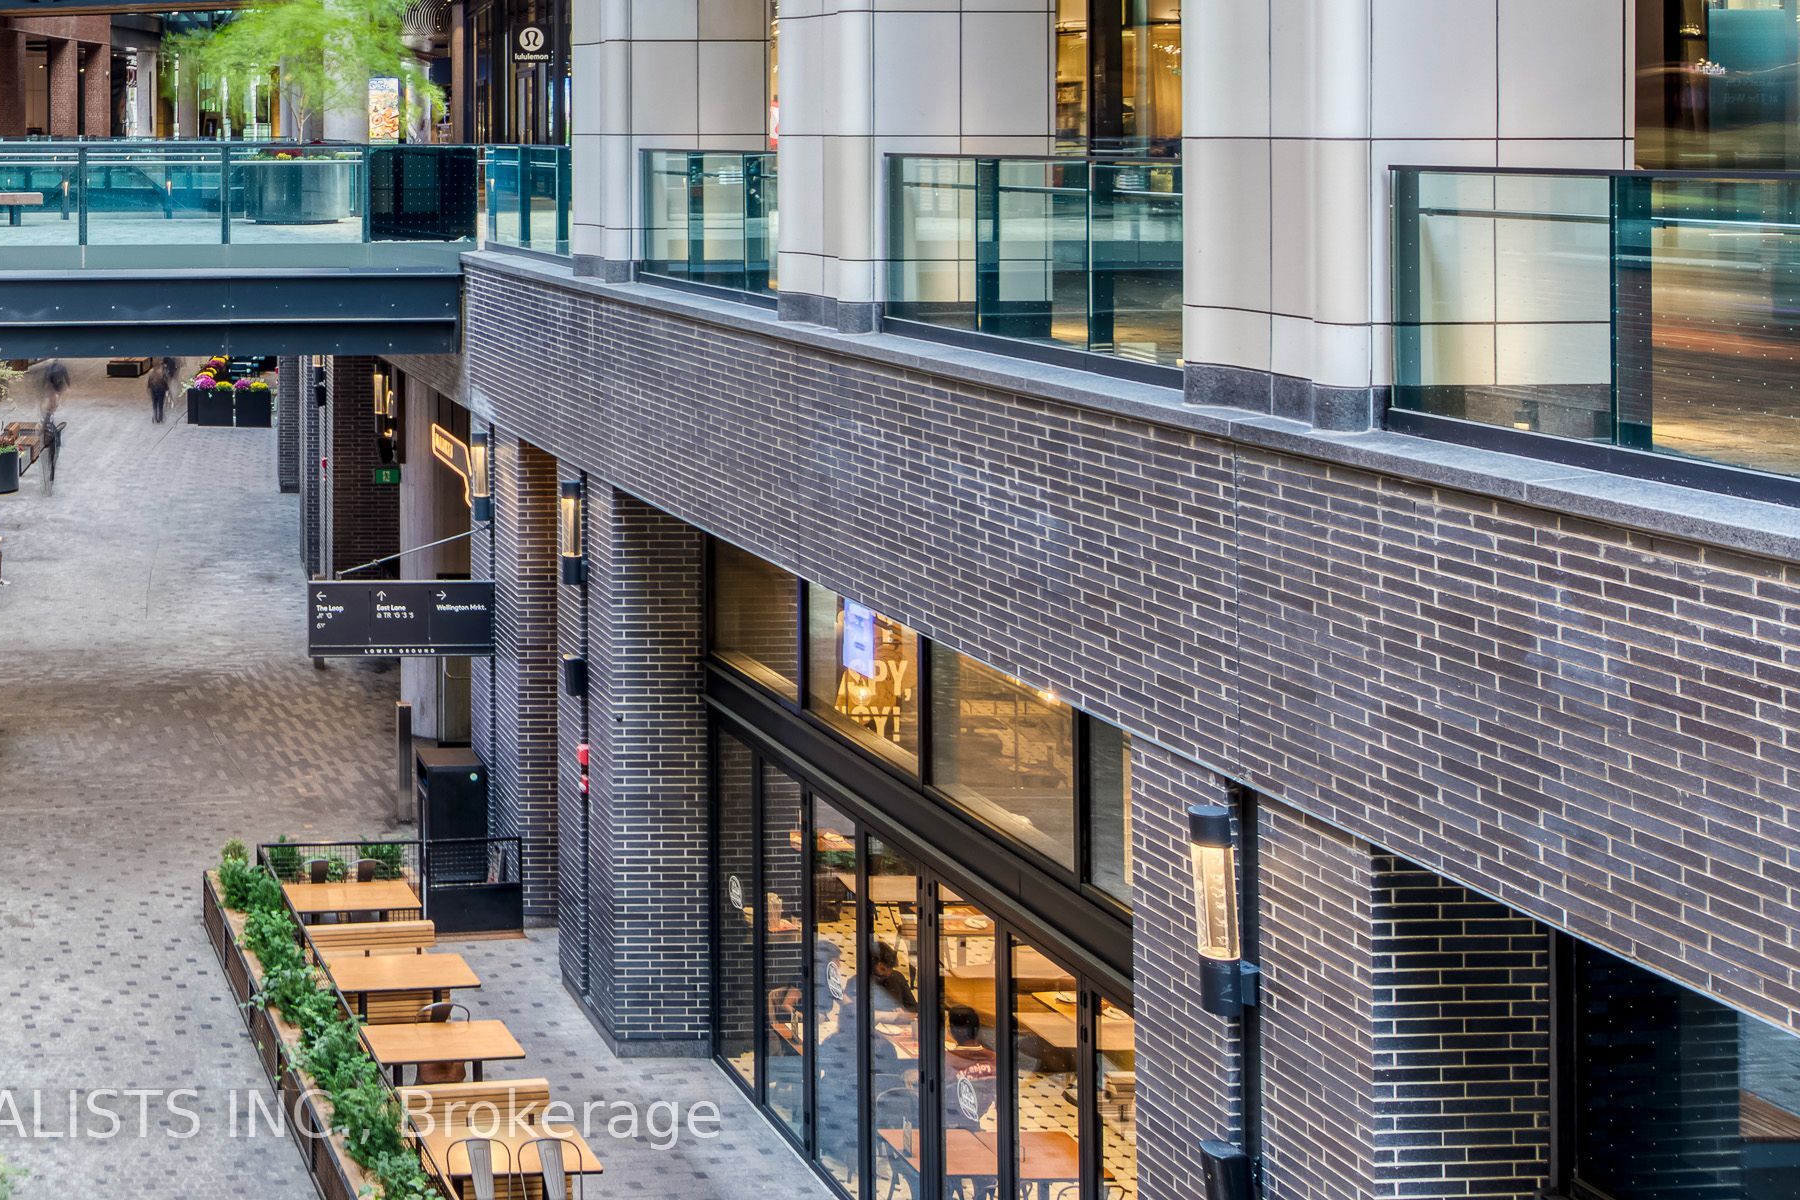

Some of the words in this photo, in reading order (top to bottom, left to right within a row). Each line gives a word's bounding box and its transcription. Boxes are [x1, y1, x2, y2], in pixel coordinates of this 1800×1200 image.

[514, 52, 549, 60] lululemon
[316, 604, 328, 612] The
[328, 604, 344, 613] Loop
[436, 604, 469, 613] Wellington
[469, 604, 487, 612] Mrkt.
